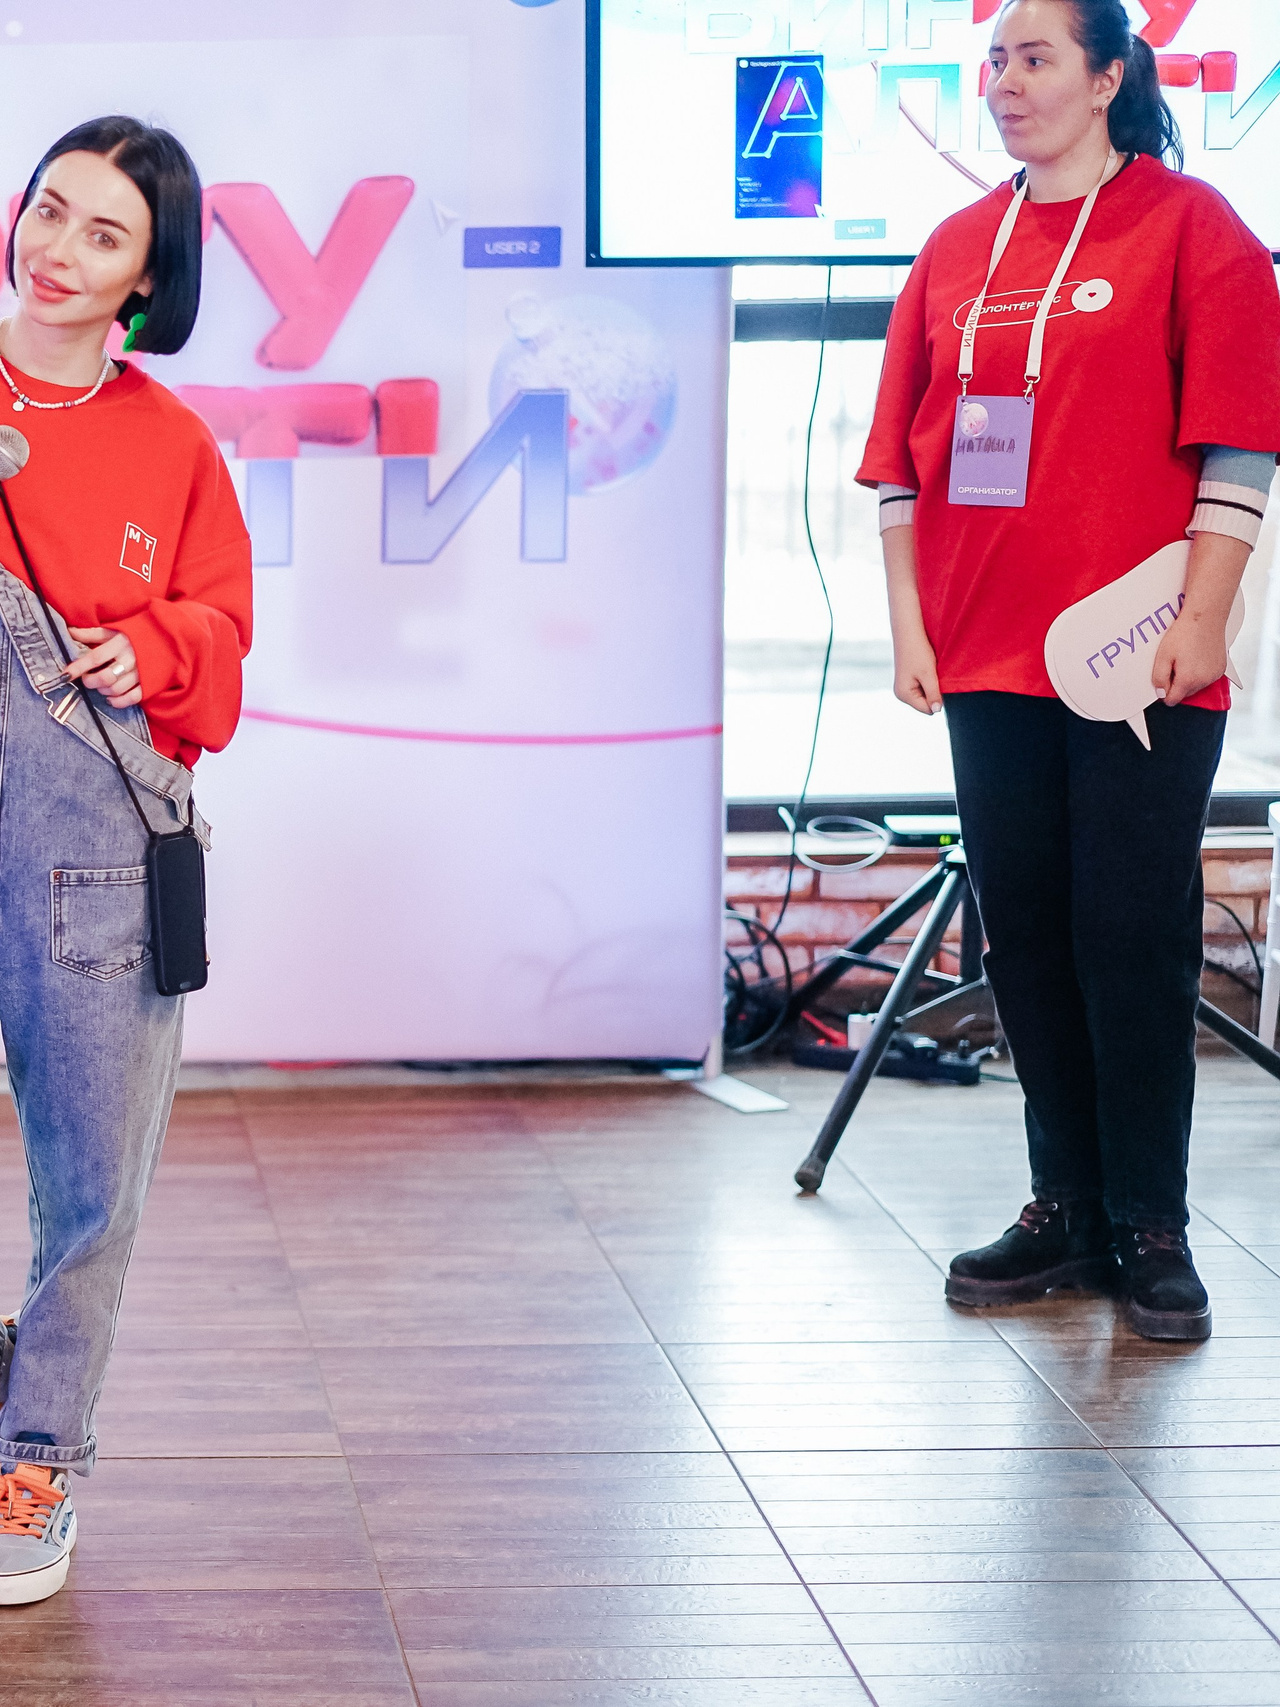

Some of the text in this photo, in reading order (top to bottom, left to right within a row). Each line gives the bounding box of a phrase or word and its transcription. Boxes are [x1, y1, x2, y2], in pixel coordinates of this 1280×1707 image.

[484, 240, 540, 255] USER 2
[978, 301, 1035, 315] ОЛОНТЁР
[957, 486, 1017, 496] ОРГАНИЗАТОР
